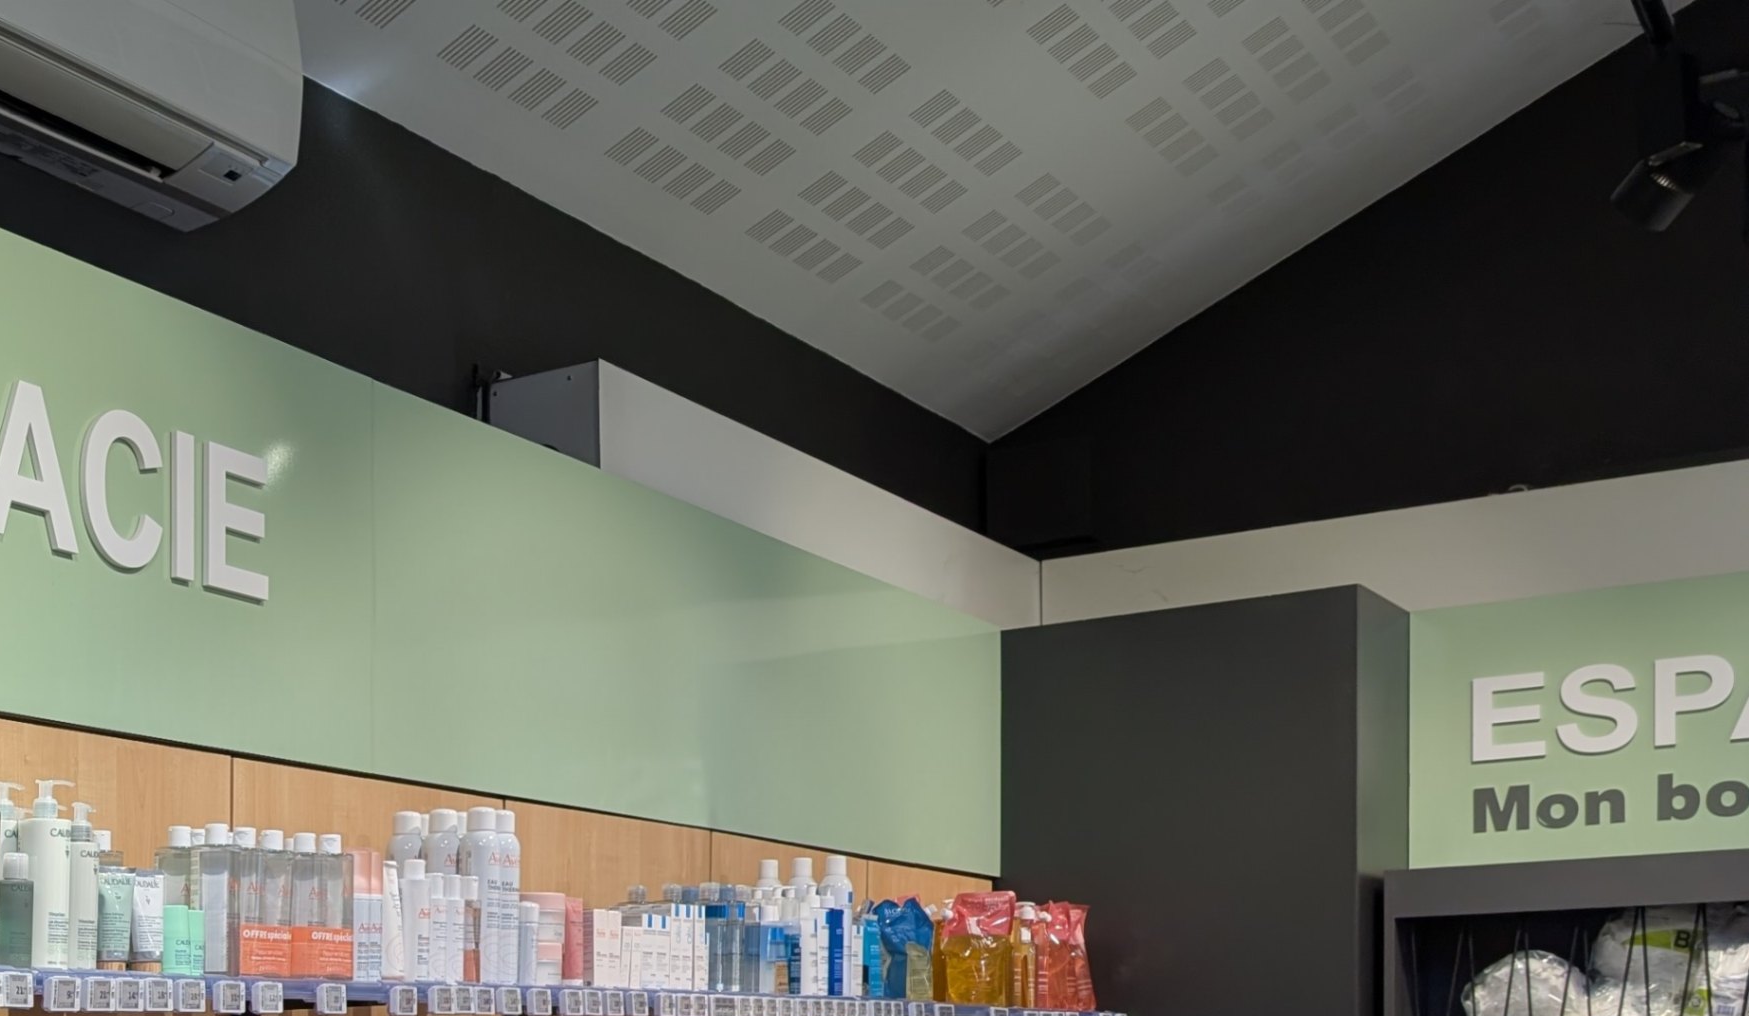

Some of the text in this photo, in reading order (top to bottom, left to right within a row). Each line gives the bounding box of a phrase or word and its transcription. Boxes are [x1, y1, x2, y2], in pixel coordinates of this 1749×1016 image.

[1471, 653, 1749, 765] ESP
[1472, 773, 1749, 834] Mon bo
